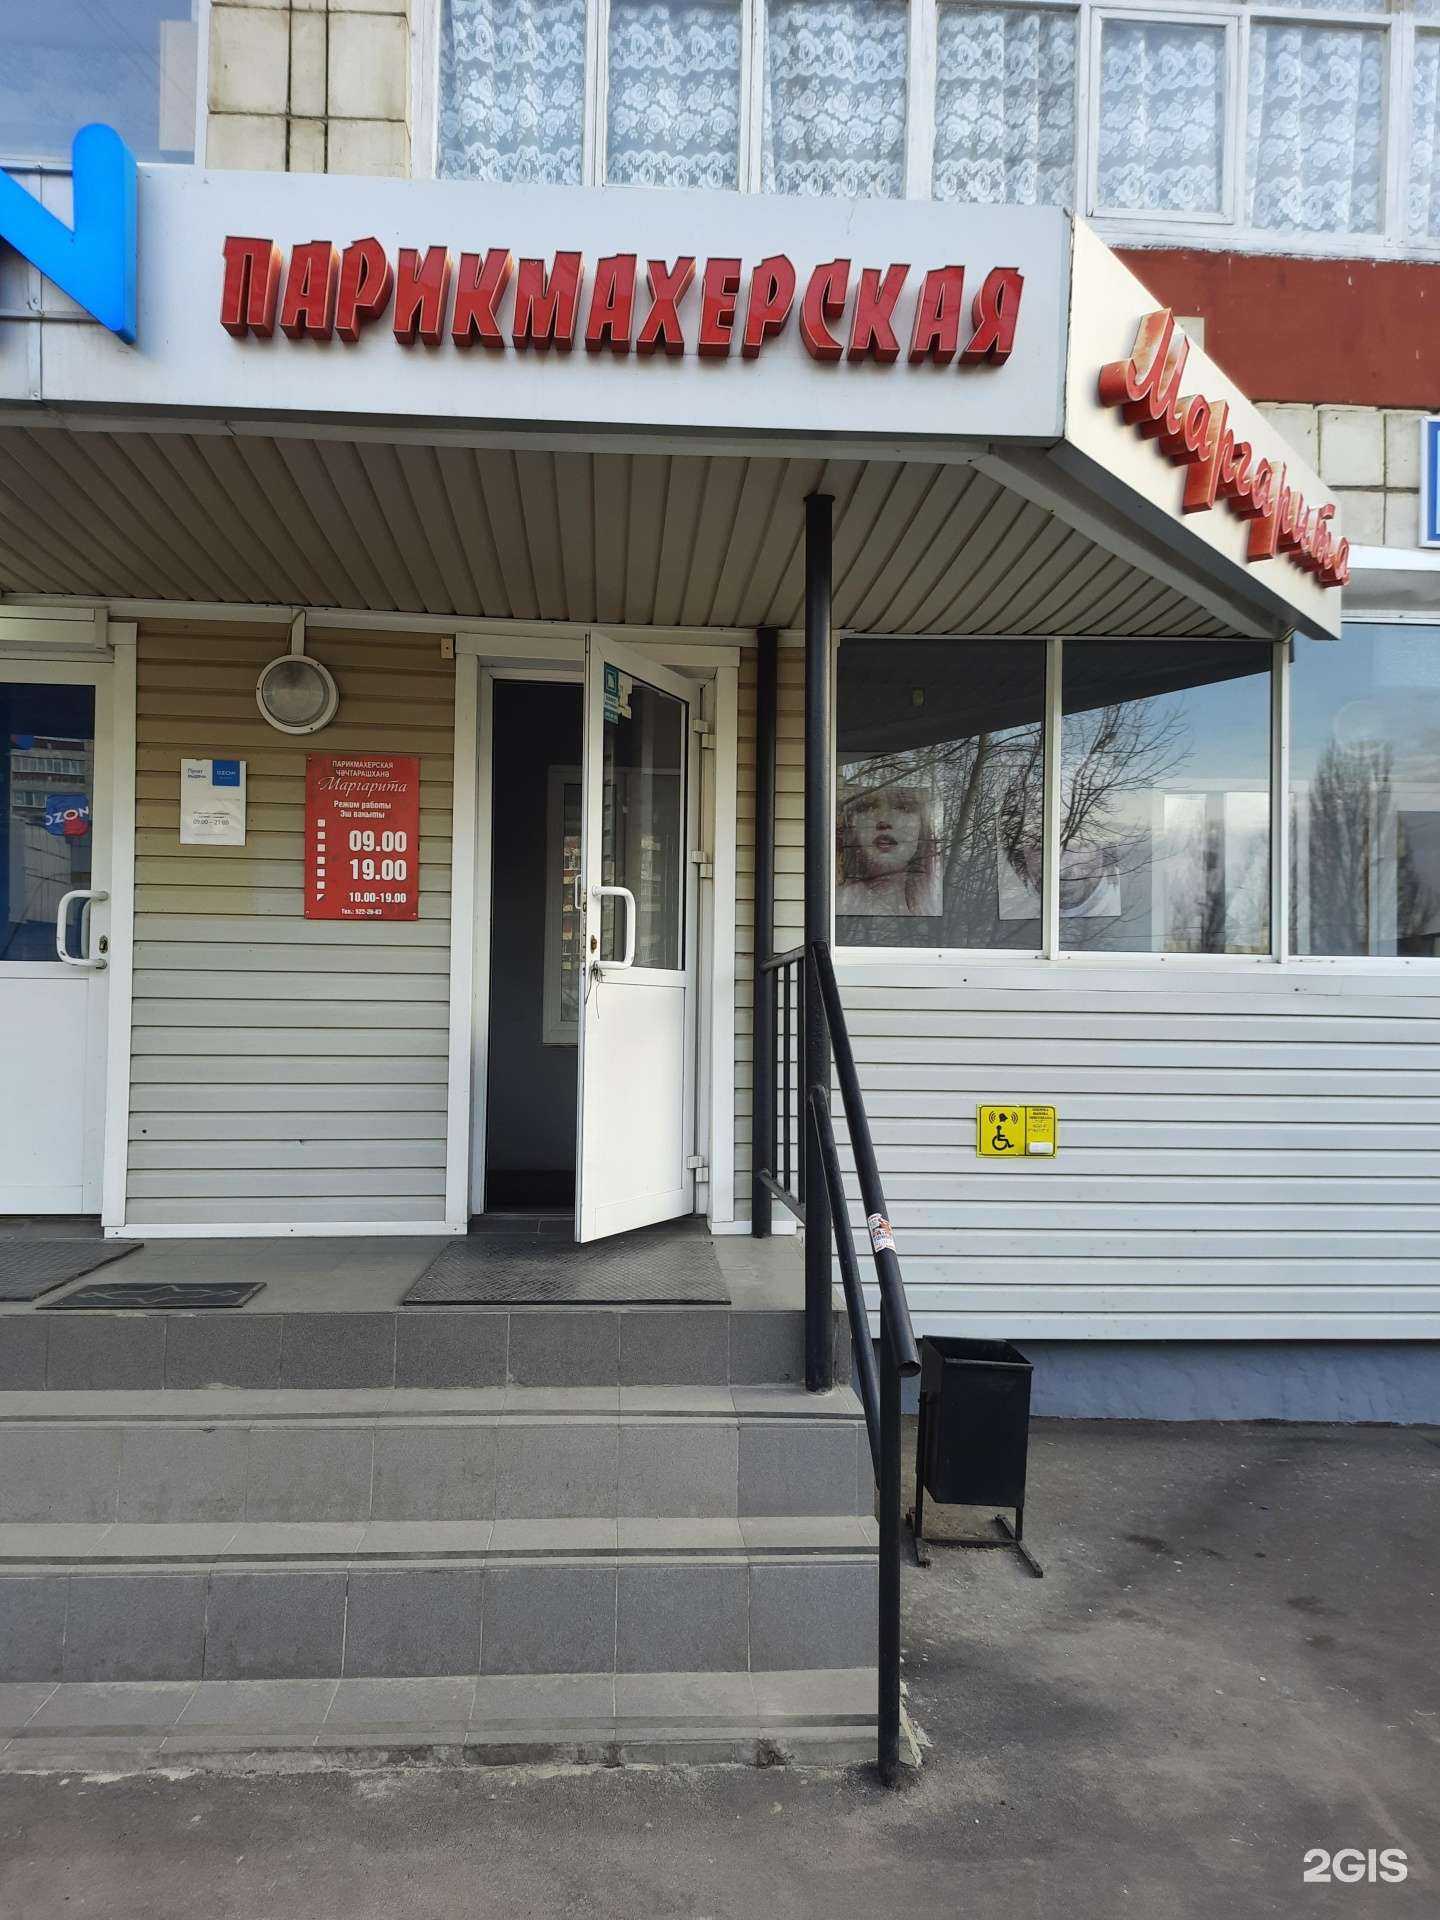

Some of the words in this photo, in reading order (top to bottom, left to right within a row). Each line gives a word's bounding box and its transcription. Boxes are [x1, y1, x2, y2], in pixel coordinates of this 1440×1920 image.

[220, 235, 1024, 365] ПАРИКМАХЕРСКАЯ
[1098, 307, 1350, 588] Маргарита
[332, 760, 394, 769] ПАРИКМАХЕРСКАЯ
[317, 776, 408, 797] Маргарита
[361, 801, 392, 810] работы
[349, 829, 407, 853] 09.00
[349, 858, 407, 881] 19.00
[349, 891, 407, 903] 10.00-19.00
